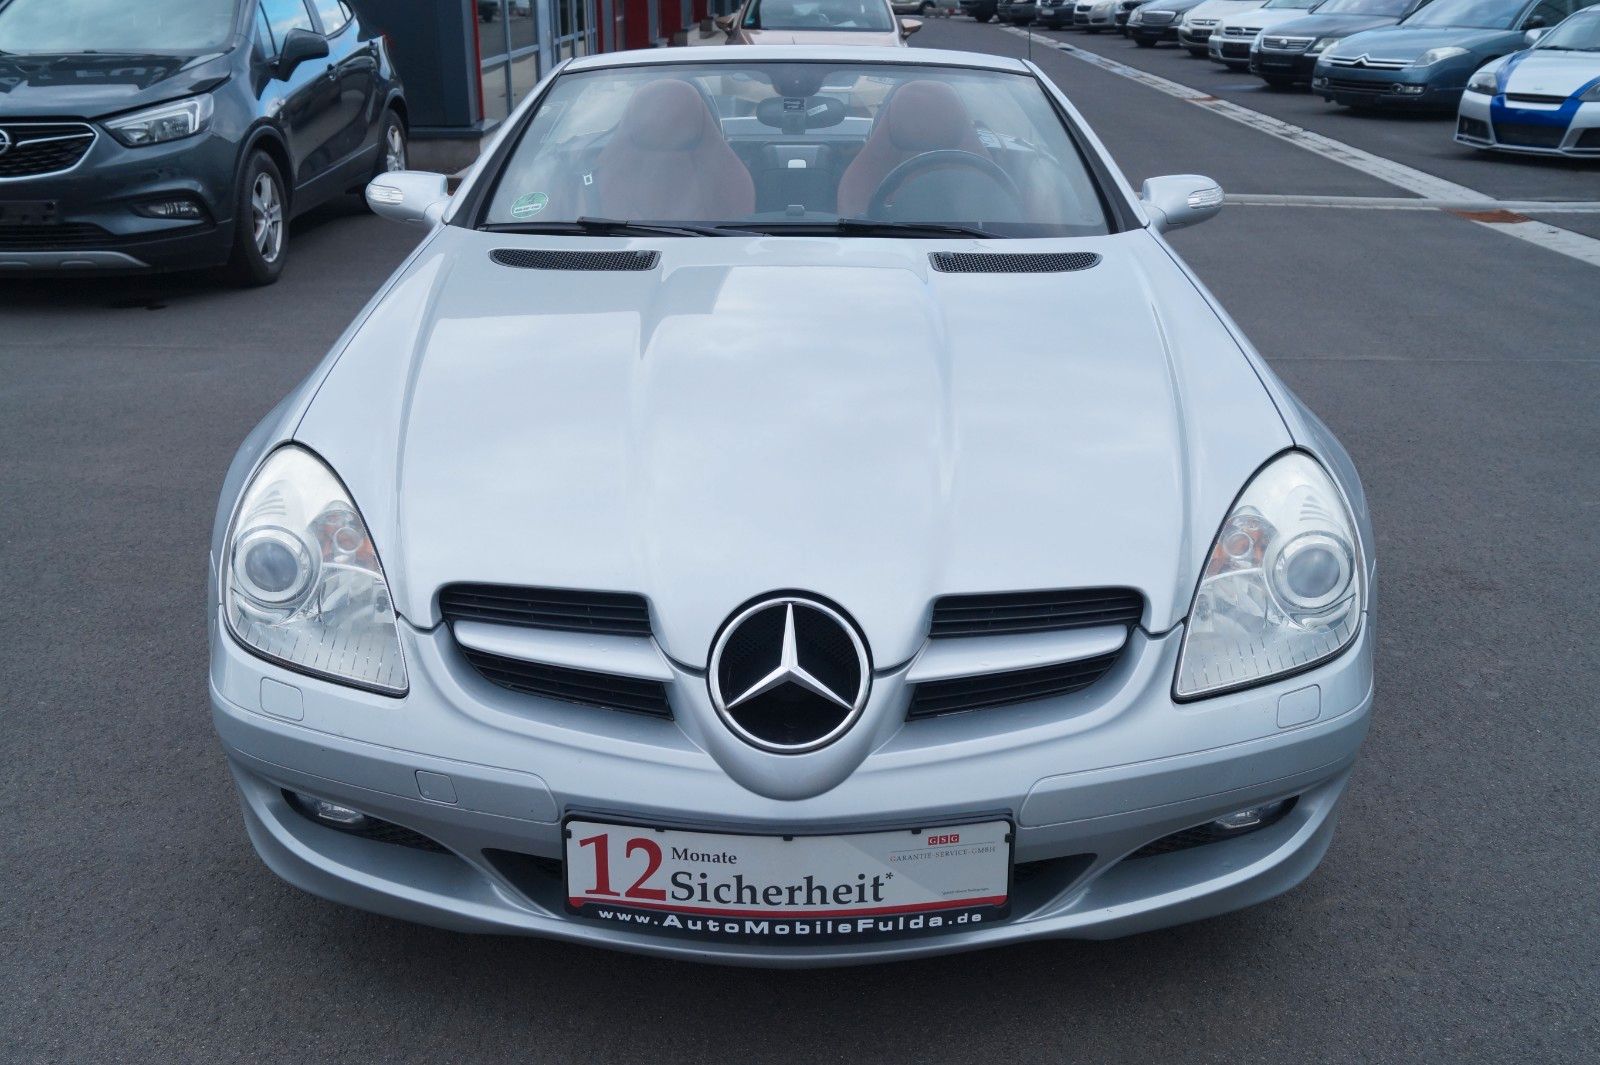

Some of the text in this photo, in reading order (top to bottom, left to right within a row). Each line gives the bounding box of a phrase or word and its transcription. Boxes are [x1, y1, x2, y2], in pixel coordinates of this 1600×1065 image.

[928, 834, 960, 846] GSG
[671, 847, 738, 865] Monate
[579, 833, 667, 901] 12
[598, 910, 983, 935] www.AutoMobileFulda.de
